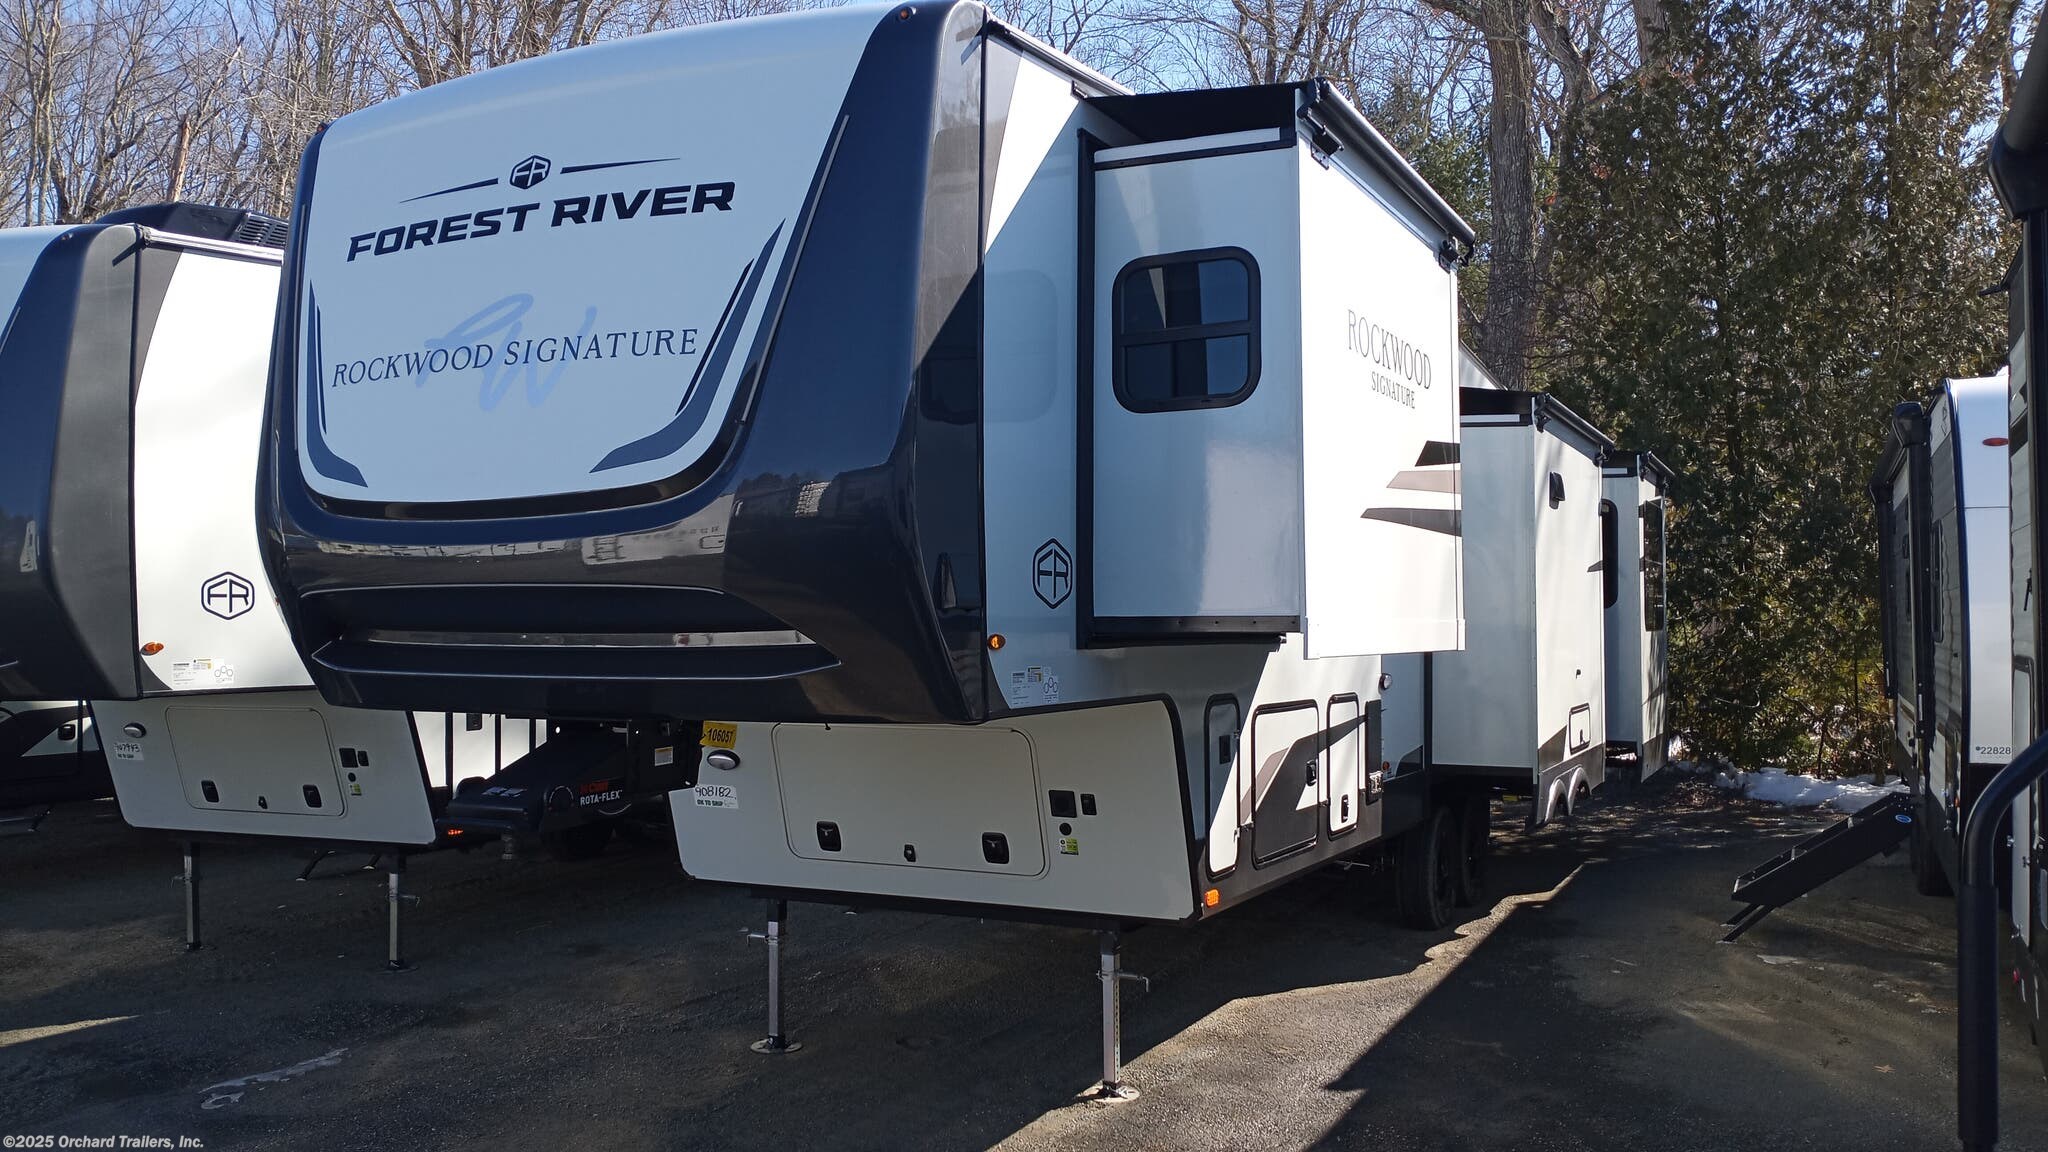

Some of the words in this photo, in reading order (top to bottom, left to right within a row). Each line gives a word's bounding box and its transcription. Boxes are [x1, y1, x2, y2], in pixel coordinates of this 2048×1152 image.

[346, 202, 541, 262] FOREST
[550, 181, 736, 227] RIVER
[331, 344, 493, 387] ROCKWOOD
[504, 328, 699, 366] SIGNATURE
[1347, 308, 1432, 390] ROCKWOOD
[1371, 370, 1415, 409] SIGNATURE
[695, 785, 731, 797] 908182
